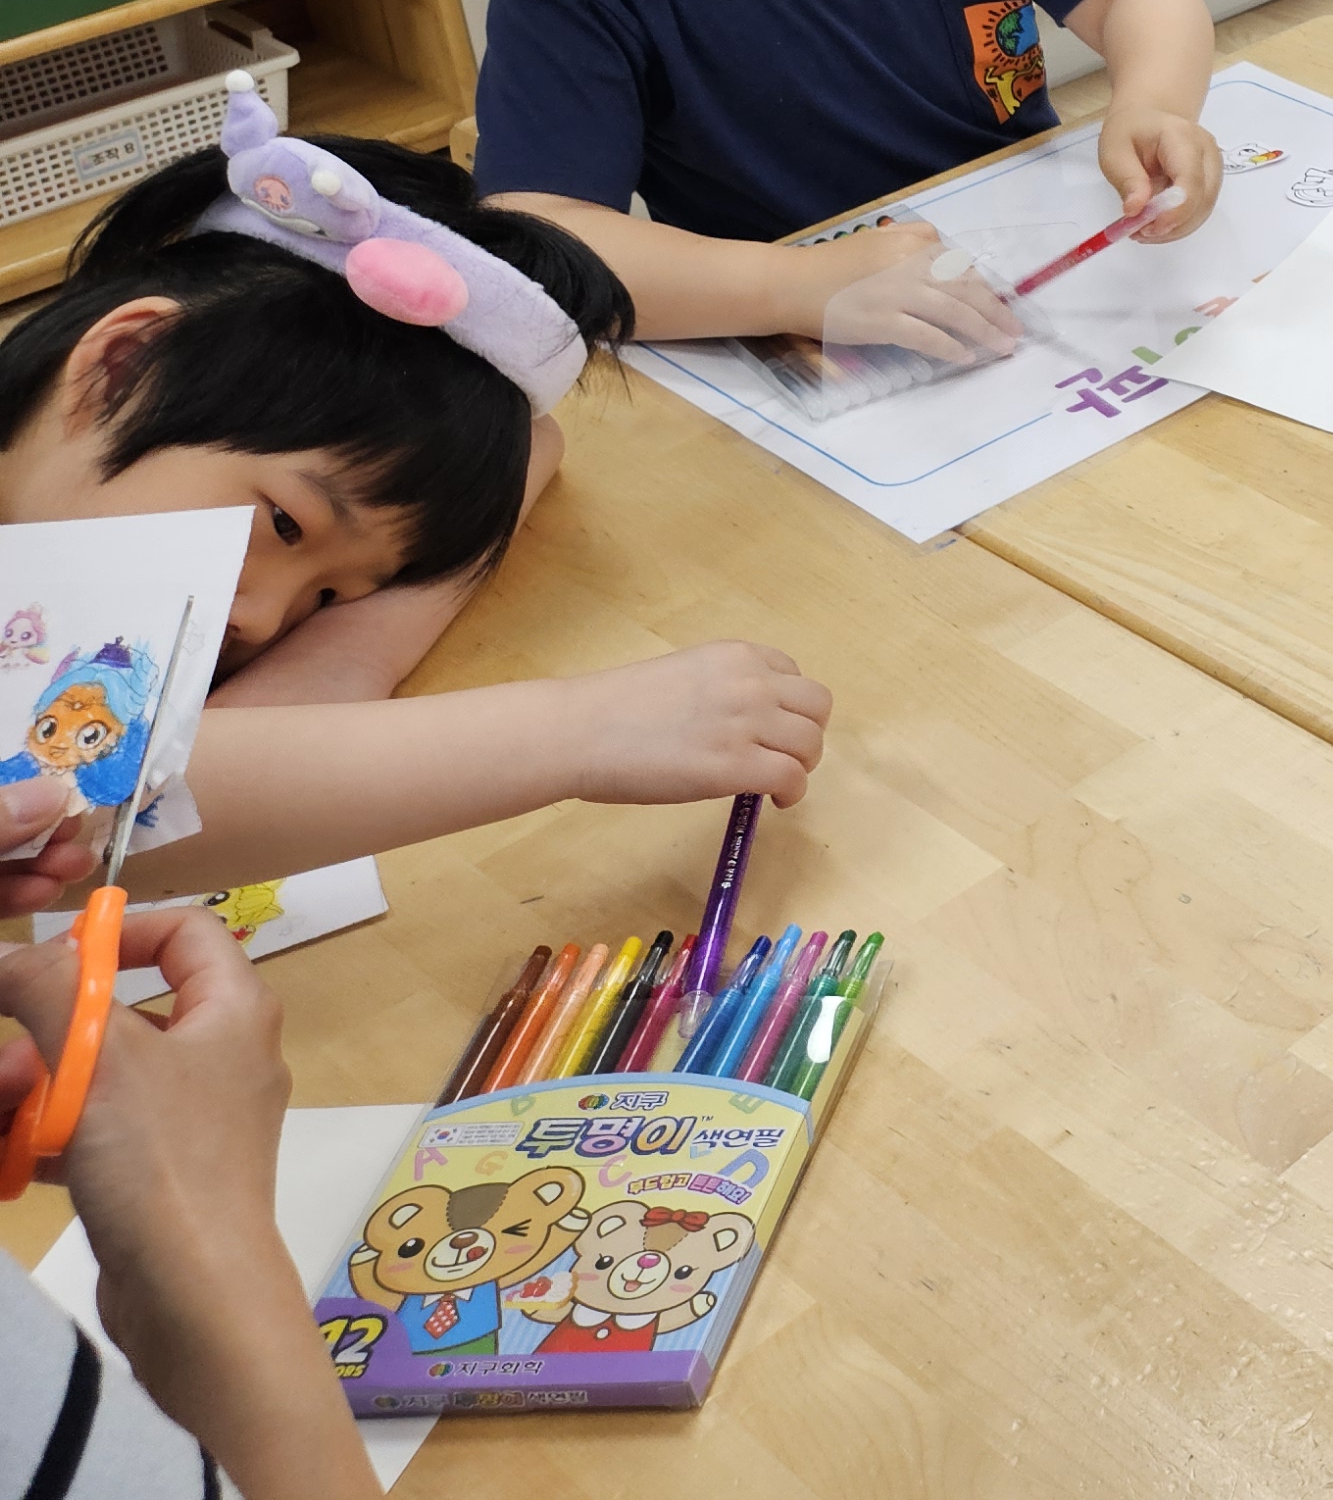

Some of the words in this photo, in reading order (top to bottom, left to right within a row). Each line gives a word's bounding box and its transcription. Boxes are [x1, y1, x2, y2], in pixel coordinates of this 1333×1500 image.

[124, 142, 135, 155] 8
[610, 1090, 670, 1111] 지구
[515, 1115, 699, 1160] 투명이
[690, 1126, 785, 1151] 색연필
[626, 1171, 691, 1196] 부드럽고
[335, 1362, 370, 1379] ORS
[453, 1359, 546, 1377] 지구화학
[527, 1389, 589, 1405] 색연필
